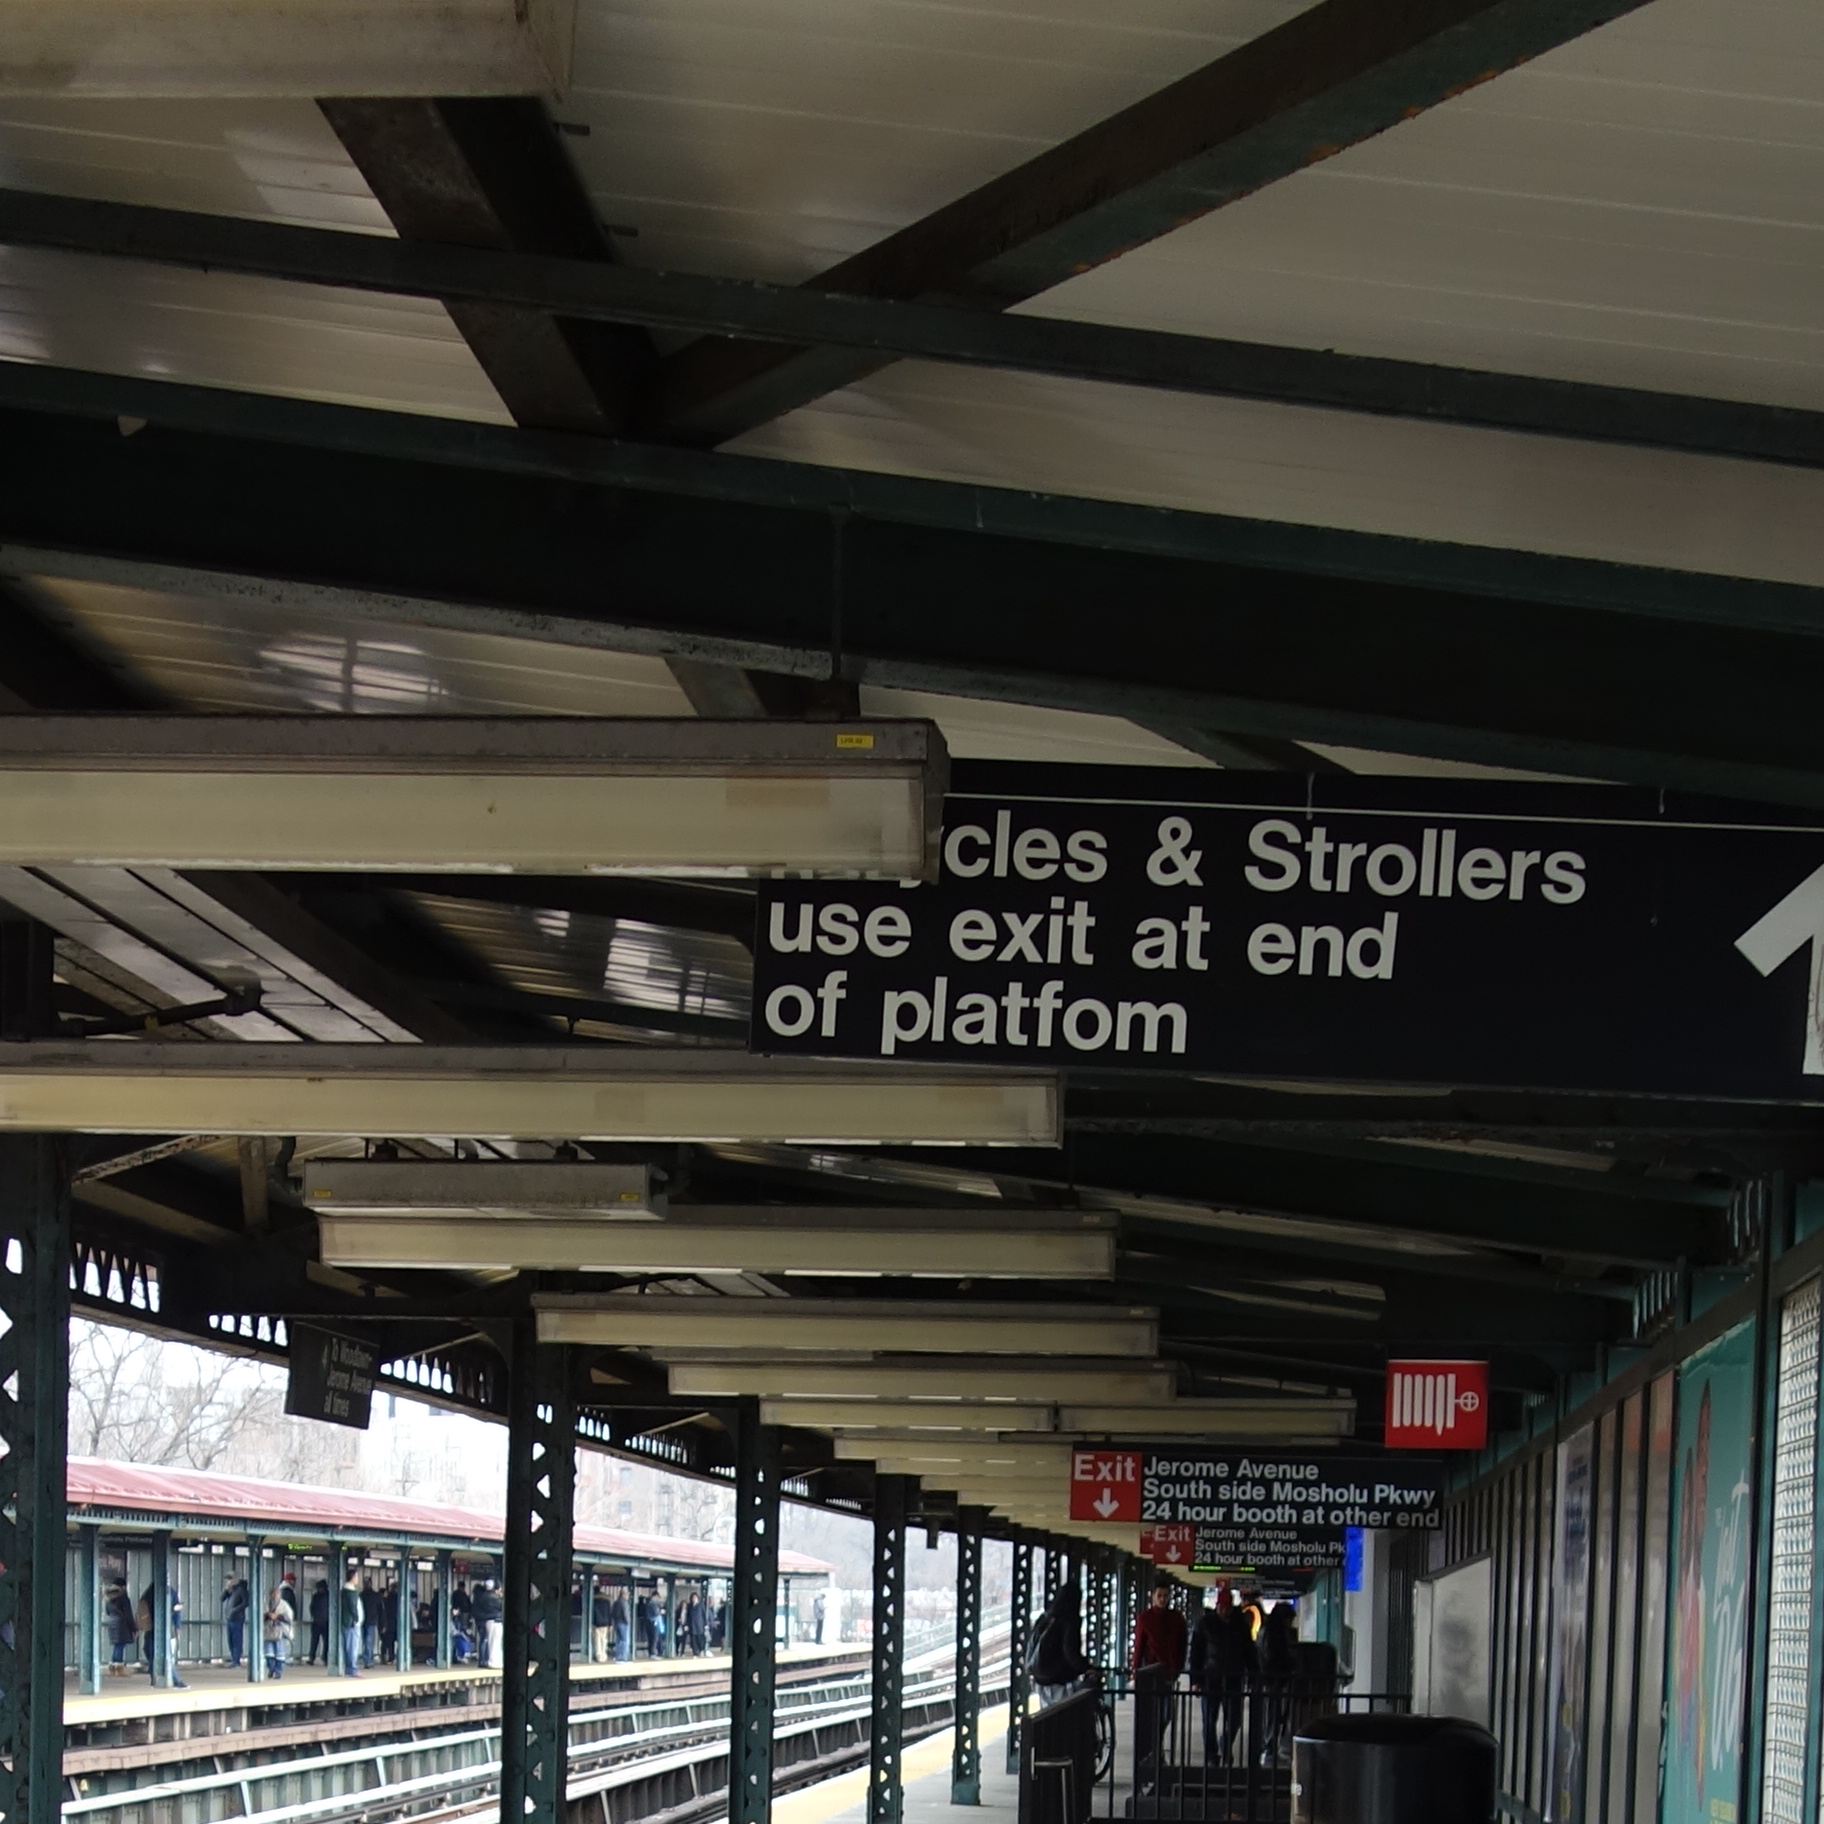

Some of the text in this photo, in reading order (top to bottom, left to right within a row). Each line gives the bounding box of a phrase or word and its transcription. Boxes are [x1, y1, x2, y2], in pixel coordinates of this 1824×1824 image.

[900, 809, 1587, 904] cles & Strollers
[768, 896, 1399, 980] use exit at end
[765, 970, 1188, 1055] of platfom
[1074, 1454, 1135, 1482] Exit
[1143, 1456, 1320, 1480] Jerome Avenue
[1142, 1478, 1436, 1509] South side Mosholu Pkwy
[1142, 1501, 1439, 1528] 24 hour booth at other end
[1154, 1525, 1191, 1542] Exit
[1195, 1526, 1297, 1540] Jerome Avenue
[1195, 1539, 1346, 1554] South side Mosholu Pk
[1194, 1552, 1212, 1564] 24
[1215, 1552, 1243, 1565] hour
[1247, 1553, 1285, 1566] booth
[1288, 1555, 1301, 1566] at
[1304, 1554, 1339, 1567] other
